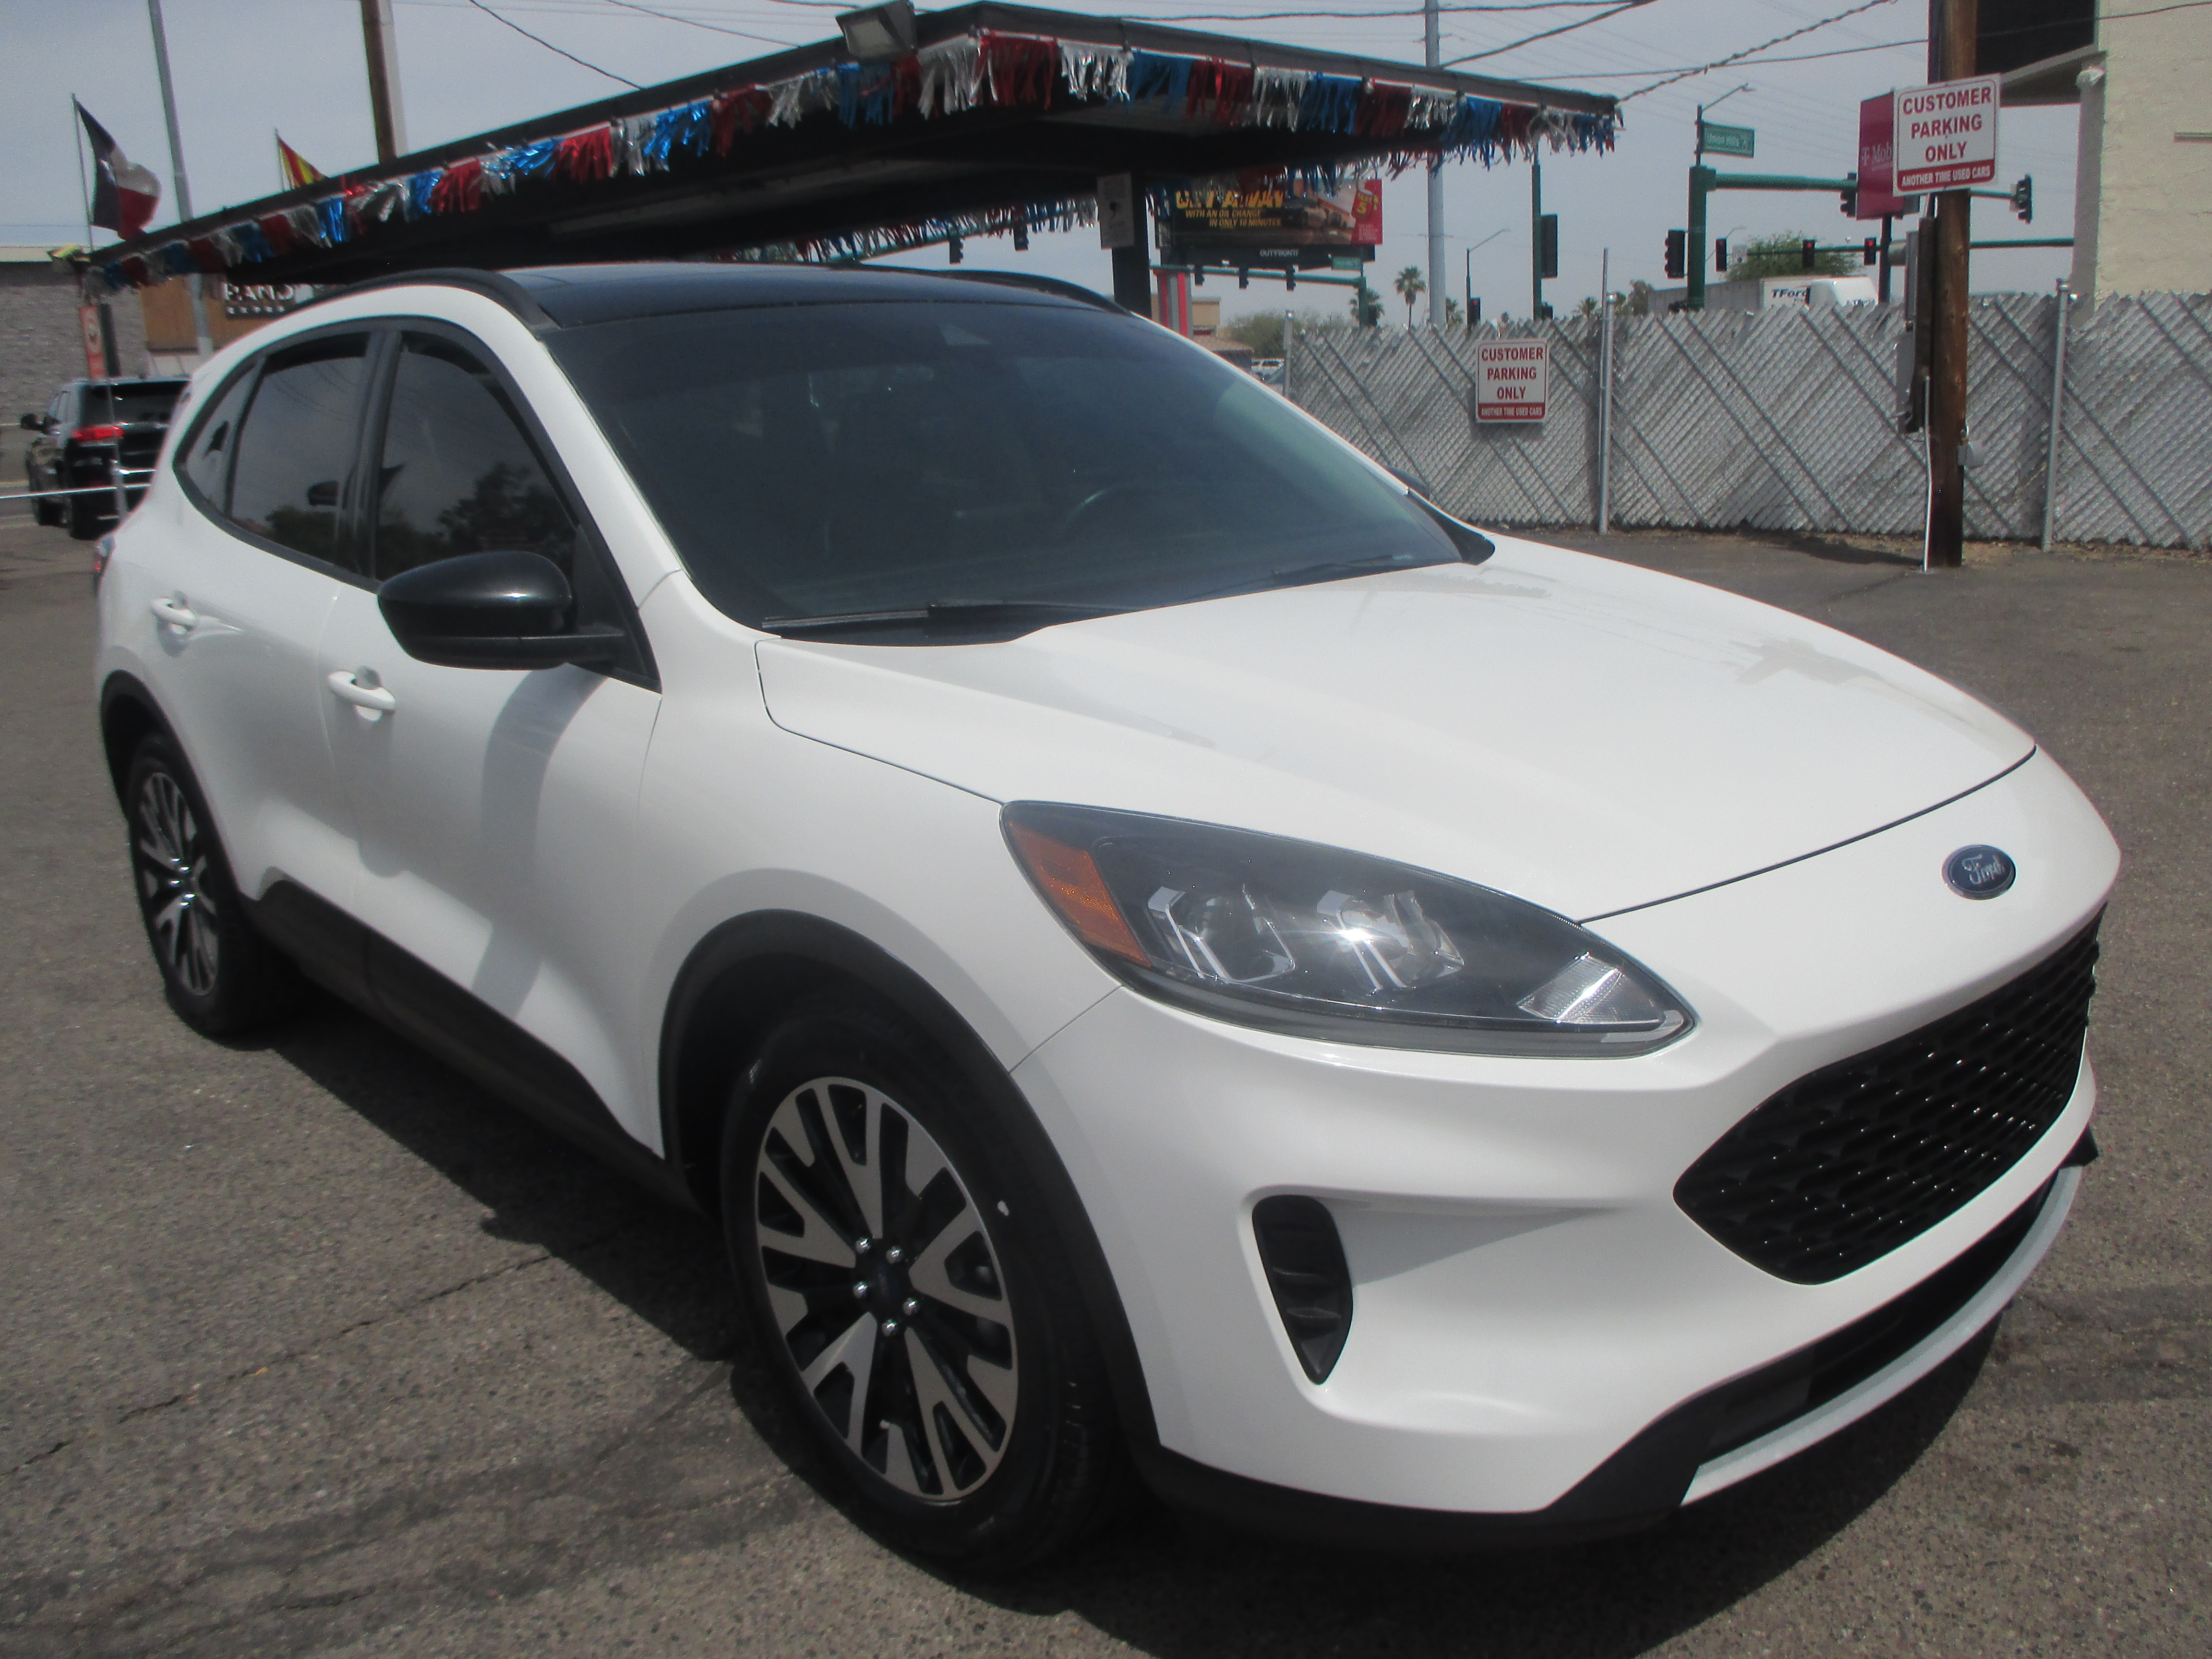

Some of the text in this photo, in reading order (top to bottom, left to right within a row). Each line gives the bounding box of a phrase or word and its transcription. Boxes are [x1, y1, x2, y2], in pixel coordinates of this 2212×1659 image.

[1902, 86, 1992, 115] CUSTOMER
[1911, 113, 1982, 140] PARKING
[1873, 142, 1893, 164] Mob
[1924, 141, 1968, 163] ONLY
[1901, 166, 1991, 187] ANOTHER TIME USED CARS
[1186, 209, 1205, 218] WITH
[1481, 347, 1543, 361] CUSTOMER
[1487, 367, 1537, 380] PARKING
[1497, 386, 1527, 399] ONLY
[1481, 408, 1503, 416] ANOTHER
[1961, 854, 2005, 885] Ford
